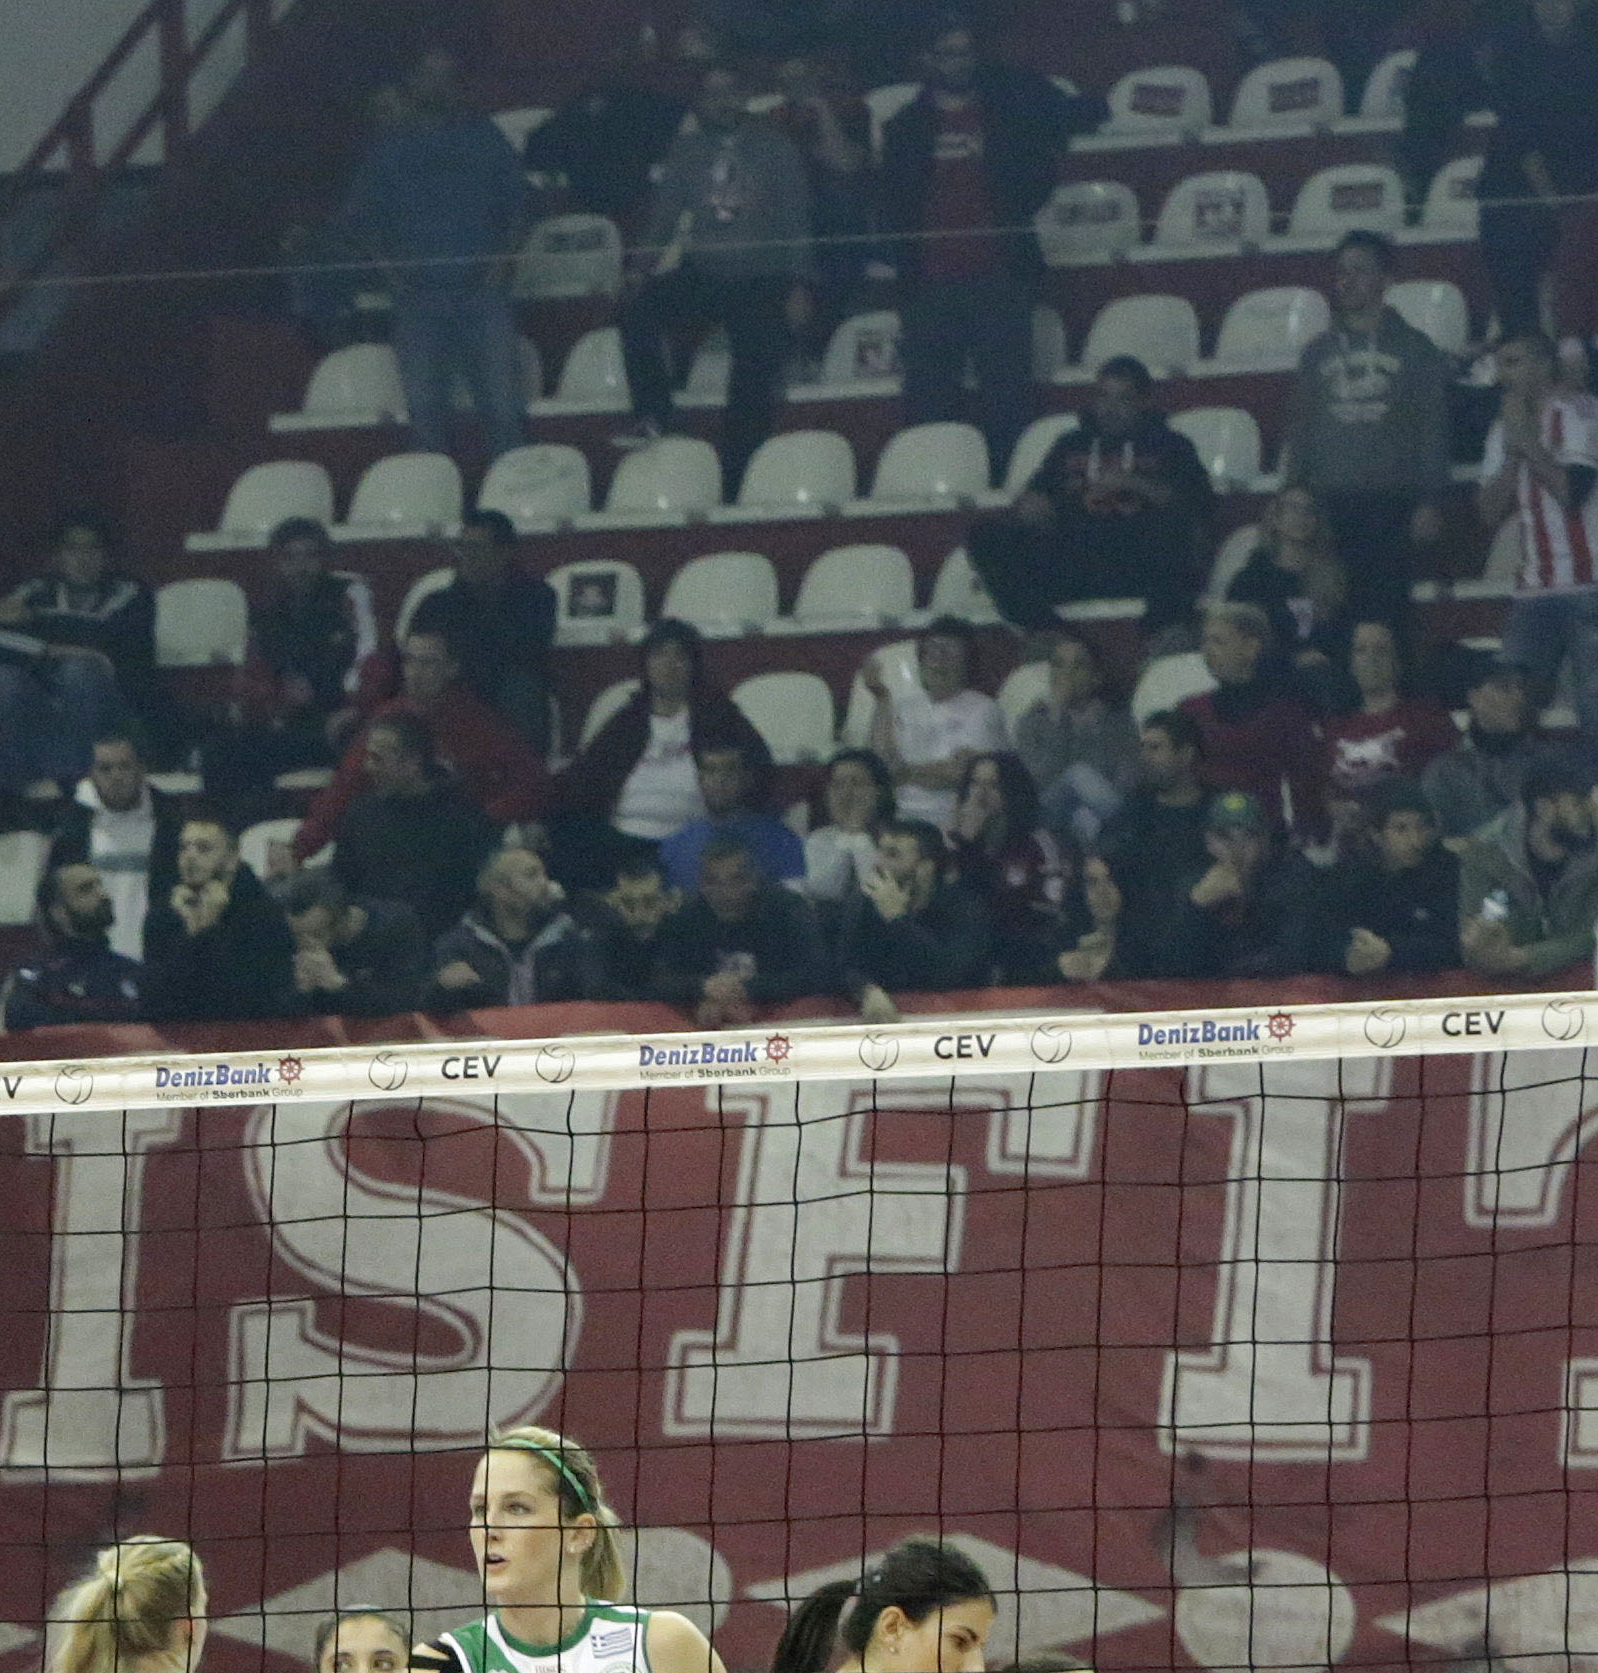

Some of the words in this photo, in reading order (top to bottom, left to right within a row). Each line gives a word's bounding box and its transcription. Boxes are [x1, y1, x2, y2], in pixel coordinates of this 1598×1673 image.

[1137, 1018, 1261, 1045] DenizBank
[1441, 1010, 1506, 1037] CEV
[638, 1041, 757, 1067] DenizBank
[933, 1033, 996, 1060] CEV
[1139, 1049, 1183, 1060] Member
[1184, 1048, 1195, 1059] of
[1197, 1046, 1259, 1058] Sberbank
[1260, 1044, 1295, 1057] Group
[155, 1062, 271, 1088] DenizBank
[441, 1054, 502, 1080] CEV
[639, 1069, 683, 1080] Member
[684, 1069, 695, 1079] of
[697, 1067, 757, 1079] Sberbank
[758, 1066, 792, 1078] Group
[156, 1091, 198, 1102] Member
[199, 1090, 209, 1100] of
[212, 1088, 270, 1099] Sberbank
[271, 1087, 304, 1098] Group
